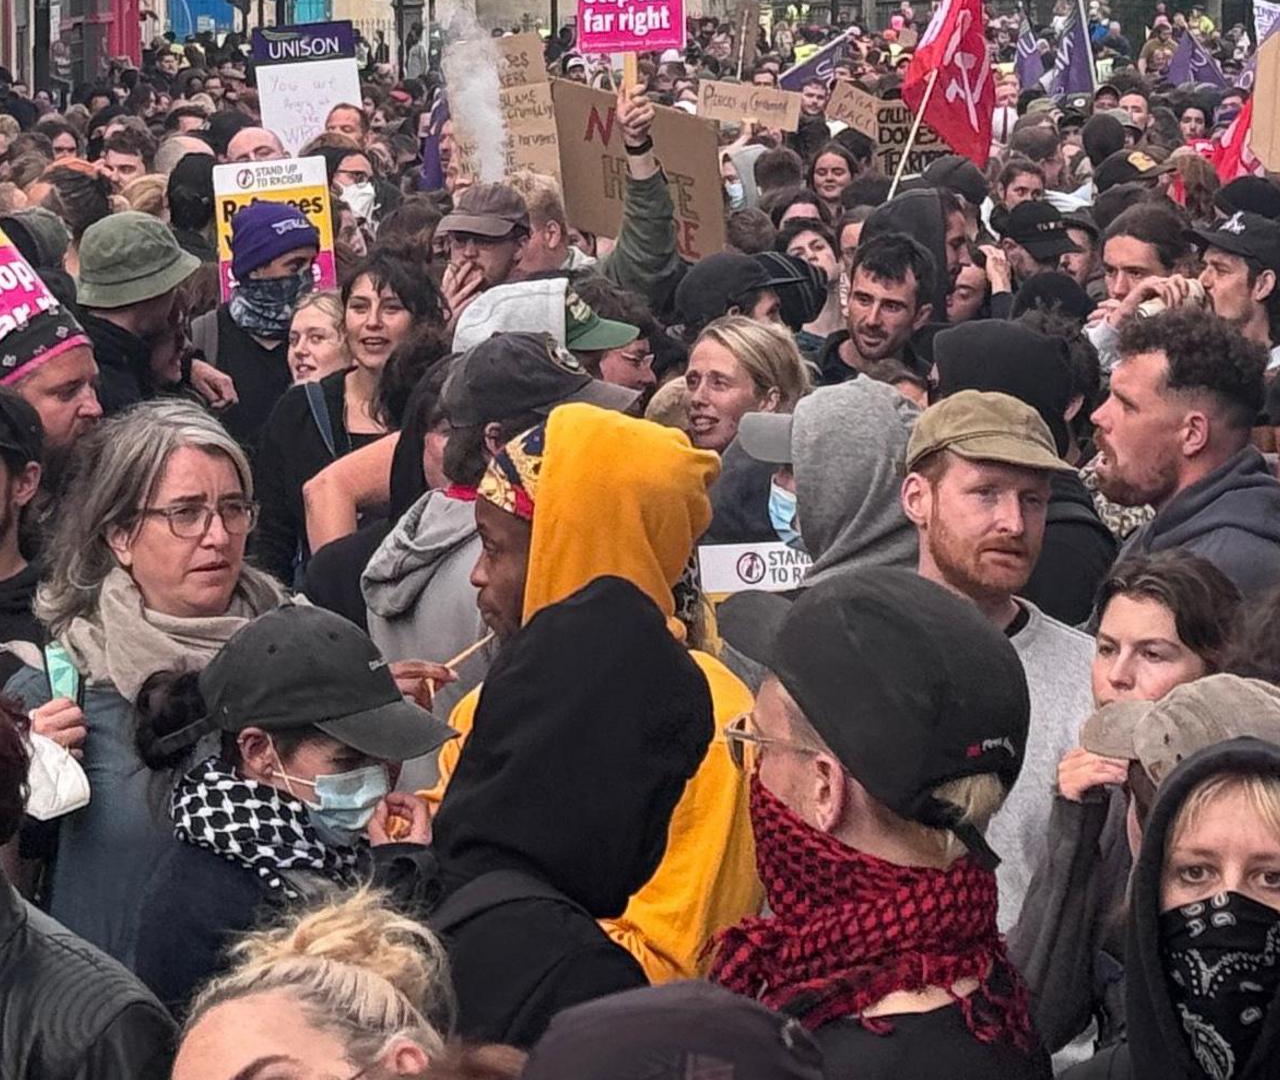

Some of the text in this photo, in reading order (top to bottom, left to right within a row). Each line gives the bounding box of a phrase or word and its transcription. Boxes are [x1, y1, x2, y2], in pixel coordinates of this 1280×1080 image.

[583, 4, 670, 36] far right
[268, 36, 340, 59] UNISON
[769, 567, 789, 583] TO
